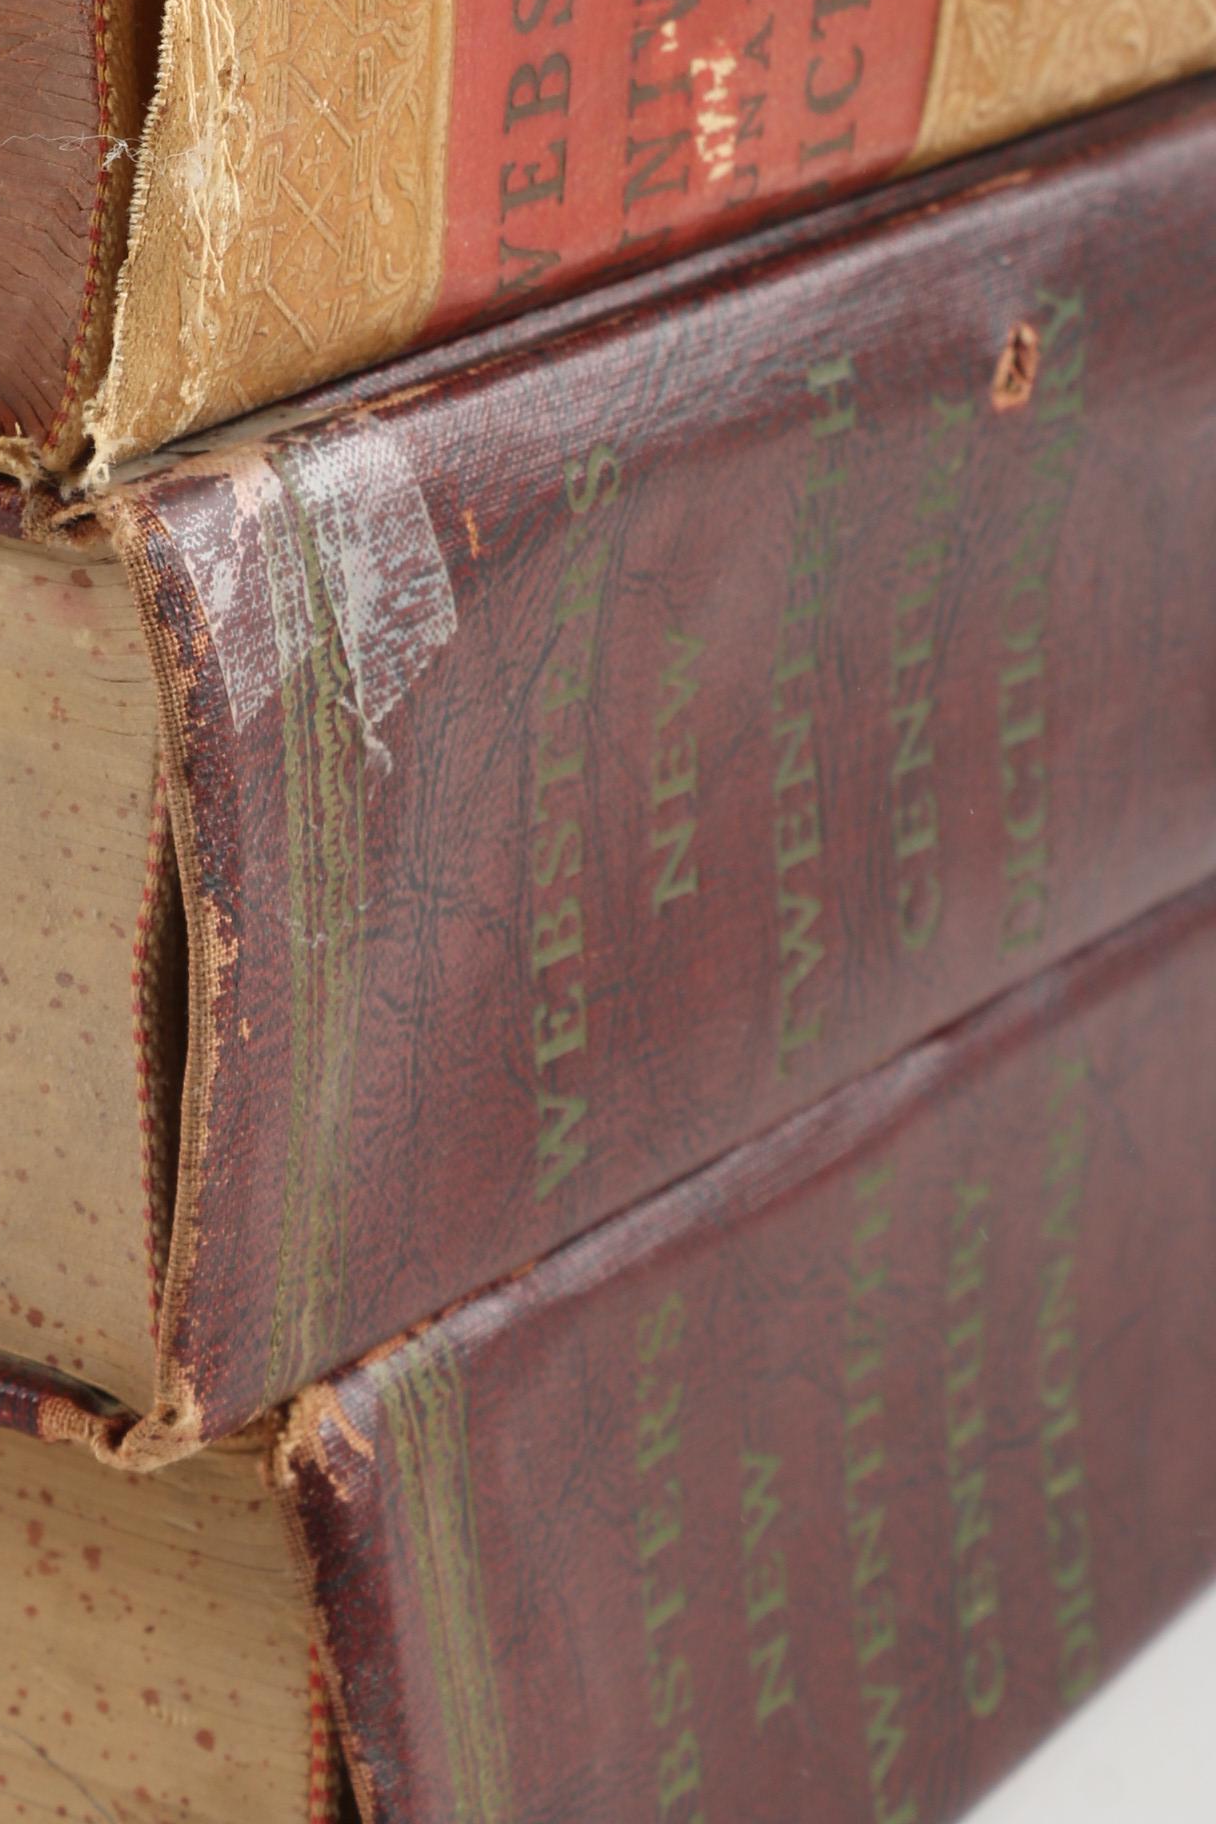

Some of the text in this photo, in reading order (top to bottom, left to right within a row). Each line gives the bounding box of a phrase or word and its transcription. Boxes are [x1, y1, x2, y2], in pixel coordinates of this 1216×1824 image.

[652, 624, 706, 916] NEW
[637, 1291, 706, 1824] BSTER'S
[742, 1451, 796, 1728] NEW
